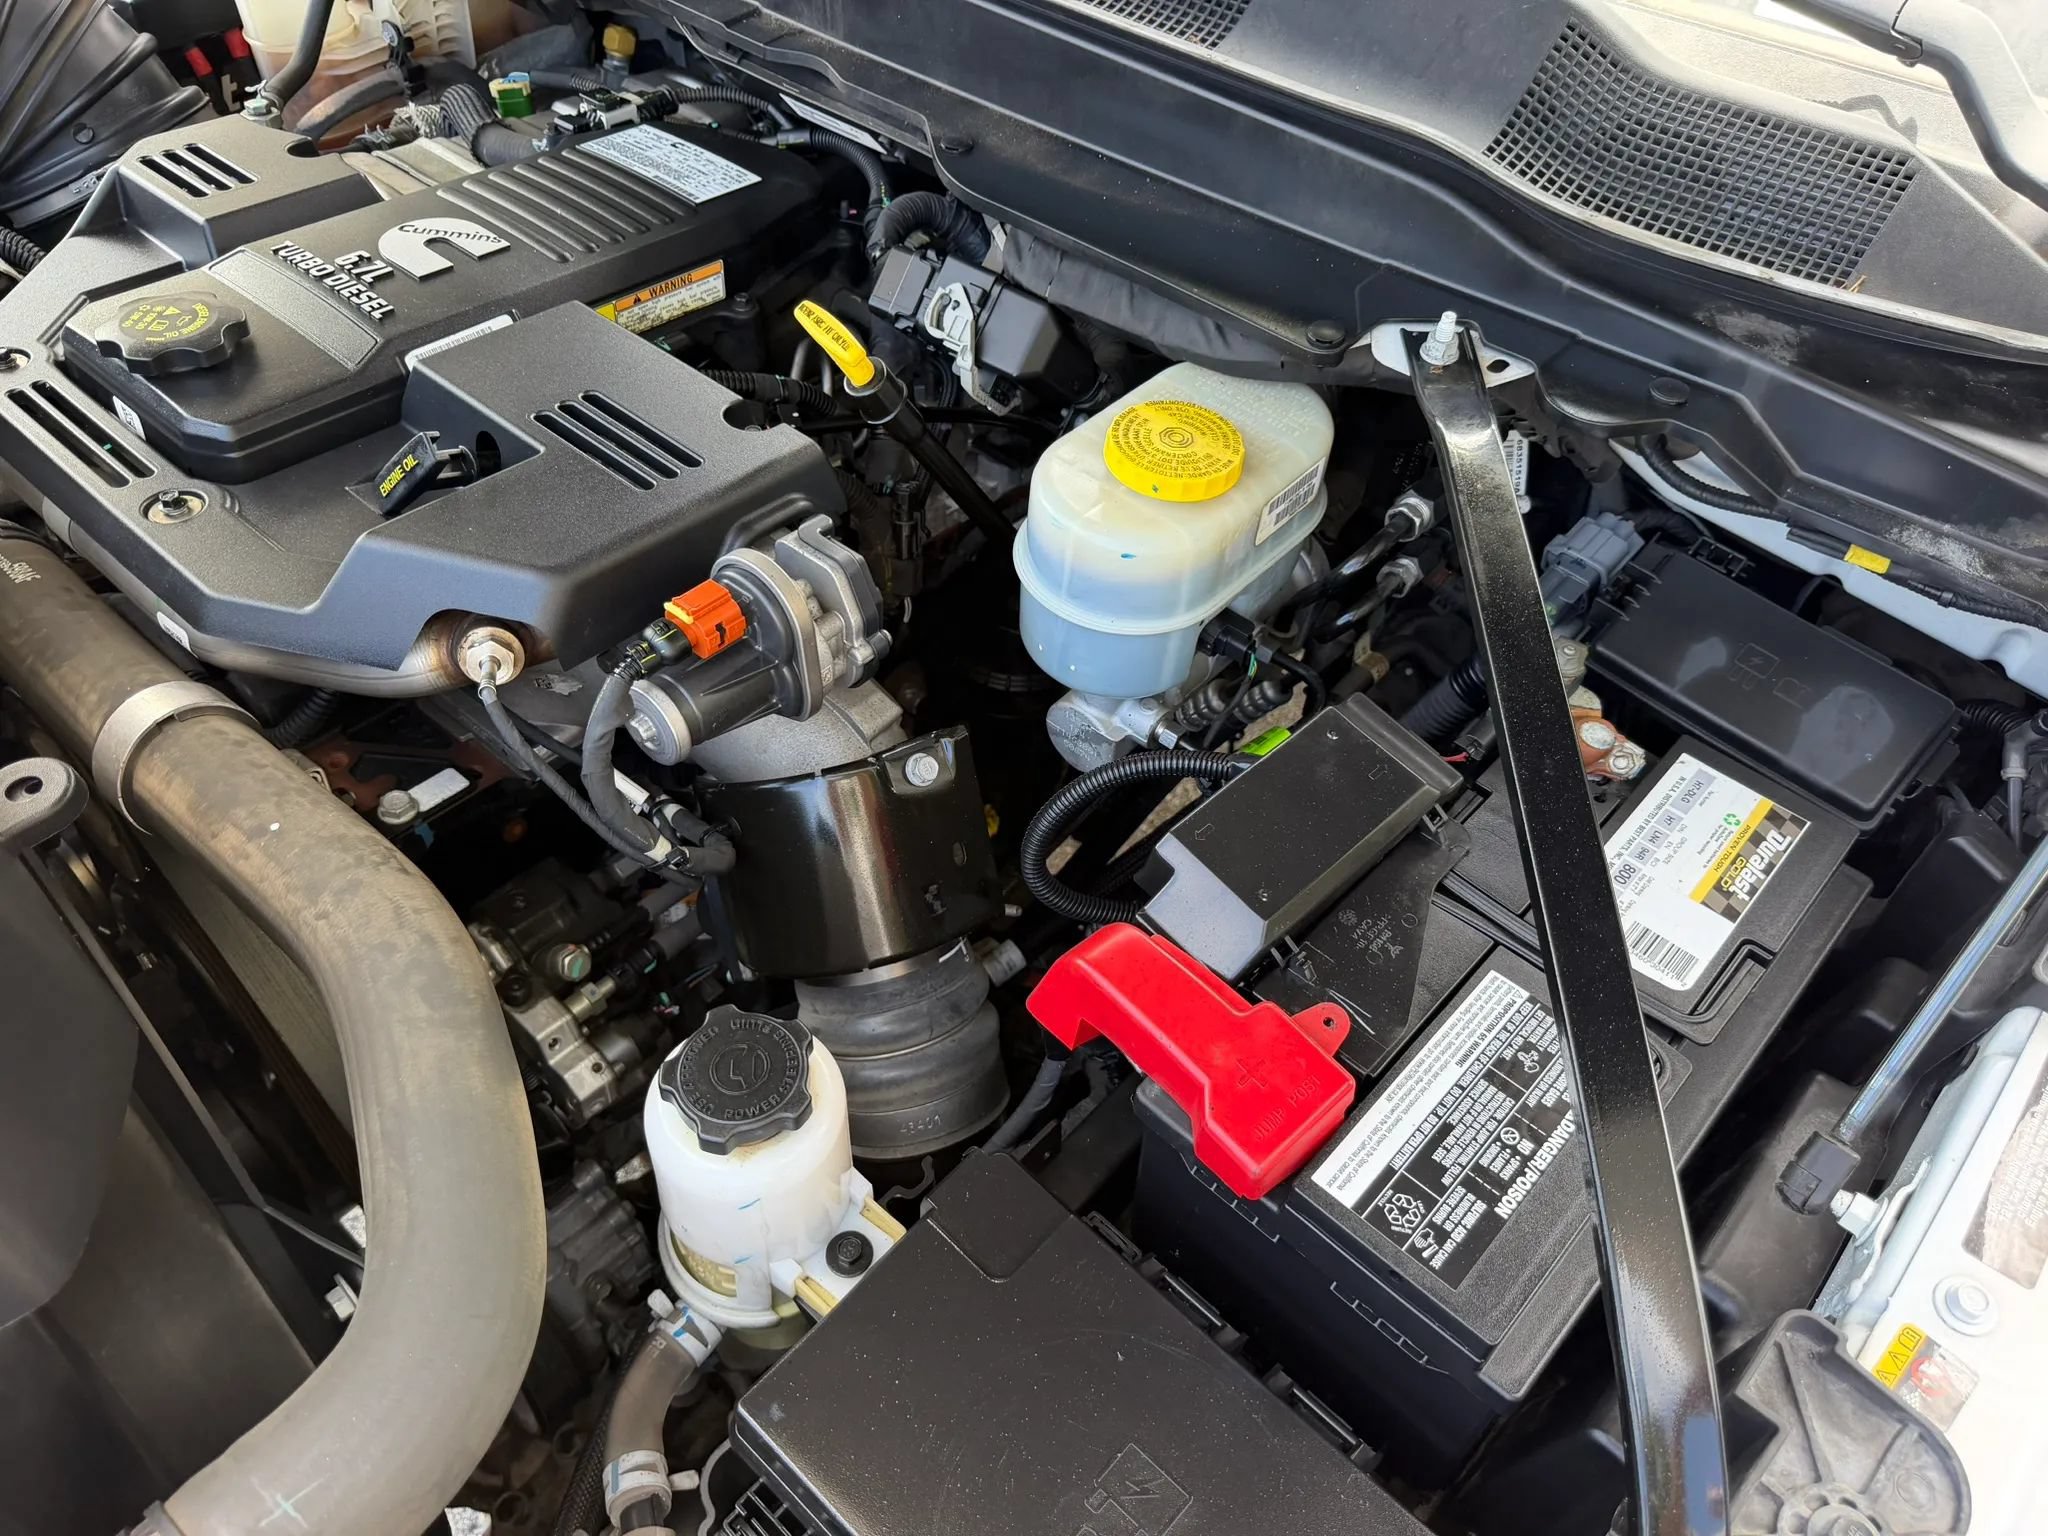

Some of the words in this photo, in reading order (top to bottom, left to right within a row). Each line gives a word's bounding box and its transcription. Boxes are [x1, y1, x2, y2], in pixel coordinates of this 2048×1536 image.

[398, 223, 503, 245] Cummins
[333, 247, 394, 284] 6.7L
[269, 238, 336, 279] TURBO
[321, 271, 395, 321] DIESEL
[647, 272, 693, 298] WARNING
[163, 330, 179, 338] OIL
[378, 463, 406, 497] ENGINE
[401, 453, 419, 472] OIL
[1679, 779, 1704, 805] H7-DLG
[1645, 791, 1673, 820] DISTRIBUTED
[1631, 823, 1646, 838] BEST
[1640, 817, 1651, 826] BY
[1661, 814, 1676, 826] H7
[1618, 834, 1637, 852] PARTS,
[1646, 829, 1664, 845] LN4
[1669, 835, 1688, 855] GROUP
[1728, 823, 1752, 851] PROVEN
[1633, 845, 1650, 861] 94R
[1661, 852, 1674, 865] SIZE
[1711, 849, 1732, 873] TOUGH
[1611, 861, 1638, 886] 800
[1721, 857, 1747, 891] GOLD
[1728, 829, 1793, 901] Duralast
[1482, 996, 1517, 1035] PROPOSITION
[1508, 1010, 1525, 1026] OUT
[1516, 999, 1534, 1017] KEEP
[1532, 1008, 1546, 1021] GET
[1502, 1020, 1517, 1033] OF
[1517, 1016, 1540, 1039] MEDICAL
[1538, 1014, 1555, 1030] WITH
[1475, 1030, 1489, 1043] 65
[1494, 1027, 1511, 1043] THE
[1508, 1034, 1525, 1050] HELP
[1525, 1025, 1546, 1046] WATER.
[680, 1025, 719, 1090] APPROVED
[1453, 1038, 1482, 1069] WARNING
[1481, 1037, 1503, 1058] REACH
[1498, 1045, 1516, 1062] FAST.
[1545, 1039, 1562, 1055] EYES
[1475, 1052, 1490, 1065] OF
[1455, 1059, 1484, 1090] CHILDREN.
[1536, 1079, 1549, 1092] OR
[1448, 1084, 1463, 1099] DO
[1467, 1077, 1489, 1100] SERVICE
[1475, 1083, 1498, 1106] MANUAL
[1523, 1086, 1544, 1108] INJURY
[1539, 1085, 1561, 1108] GASES
[723, 1092, 780, 1120] POWER
[1250, 1106, 1289, 1142] JUMP
[1286, 1073, 1322, 1108] POST
[1432, 1103, 1448, 1118] TIP.
[1440, 1092, 1456, 1108] NOT
[1444, 1094, 1475, 1127] ASSISTANCE.
[1474, 1089, 1507, 1125] INSTRUCTIONS
[1491, 1095, 1516, 1122] CAUTION:
[1417, 1120, 1434, 1136] NOT
[1425, 1112, 1440, 1126] DO
[1459, 1112, 1475, 1127] NOT
[1482, 1117, 1499, 1132] FOR
[1406, 1129, 1426, 1149] OPEN
[1439, 1121, 1467, 1152] AVAILABLE,
[1455, 1125, 1478, 1149] VEHICLE
[1472, 1126, 1491, 1145] JUMP
[1514, 1137, 1535, 1156] NO
[1387, 1142, 1415, 1171] BATTERY!
[1429, 1145, 1447, 1163] SEEK
[1439, 1143, 1463, 1168] OWNERS
[1476, 1141, 1501, 1168] SMOKING
[1487, 1149, 1511, 1174] FLAMES
[1438, 1162, 1462, 1187] FOLLOW
[1491, 1117, 1577, 1220] DANGER/POISON
[1497, 1156, 1521, 1181] SPARKS
[1377, 1189, 1395, 1207] RECYCLE
[1444, 1183, 1467, 1208] SEVERE
[1430, 1202, 1452, 1226] BURNS
[1447, 1191, 1477, 1225] BLINDNESS
[1459, 1198, 1488, 1230] SULFURIC
[1441, 1218, 1456, 1233] OR
[1448, 1223, 1468, 1243] ACID
[1440, 1236, 1458, 1254] CAN
[1427, 1247, 1449, 1271] CAUSE
